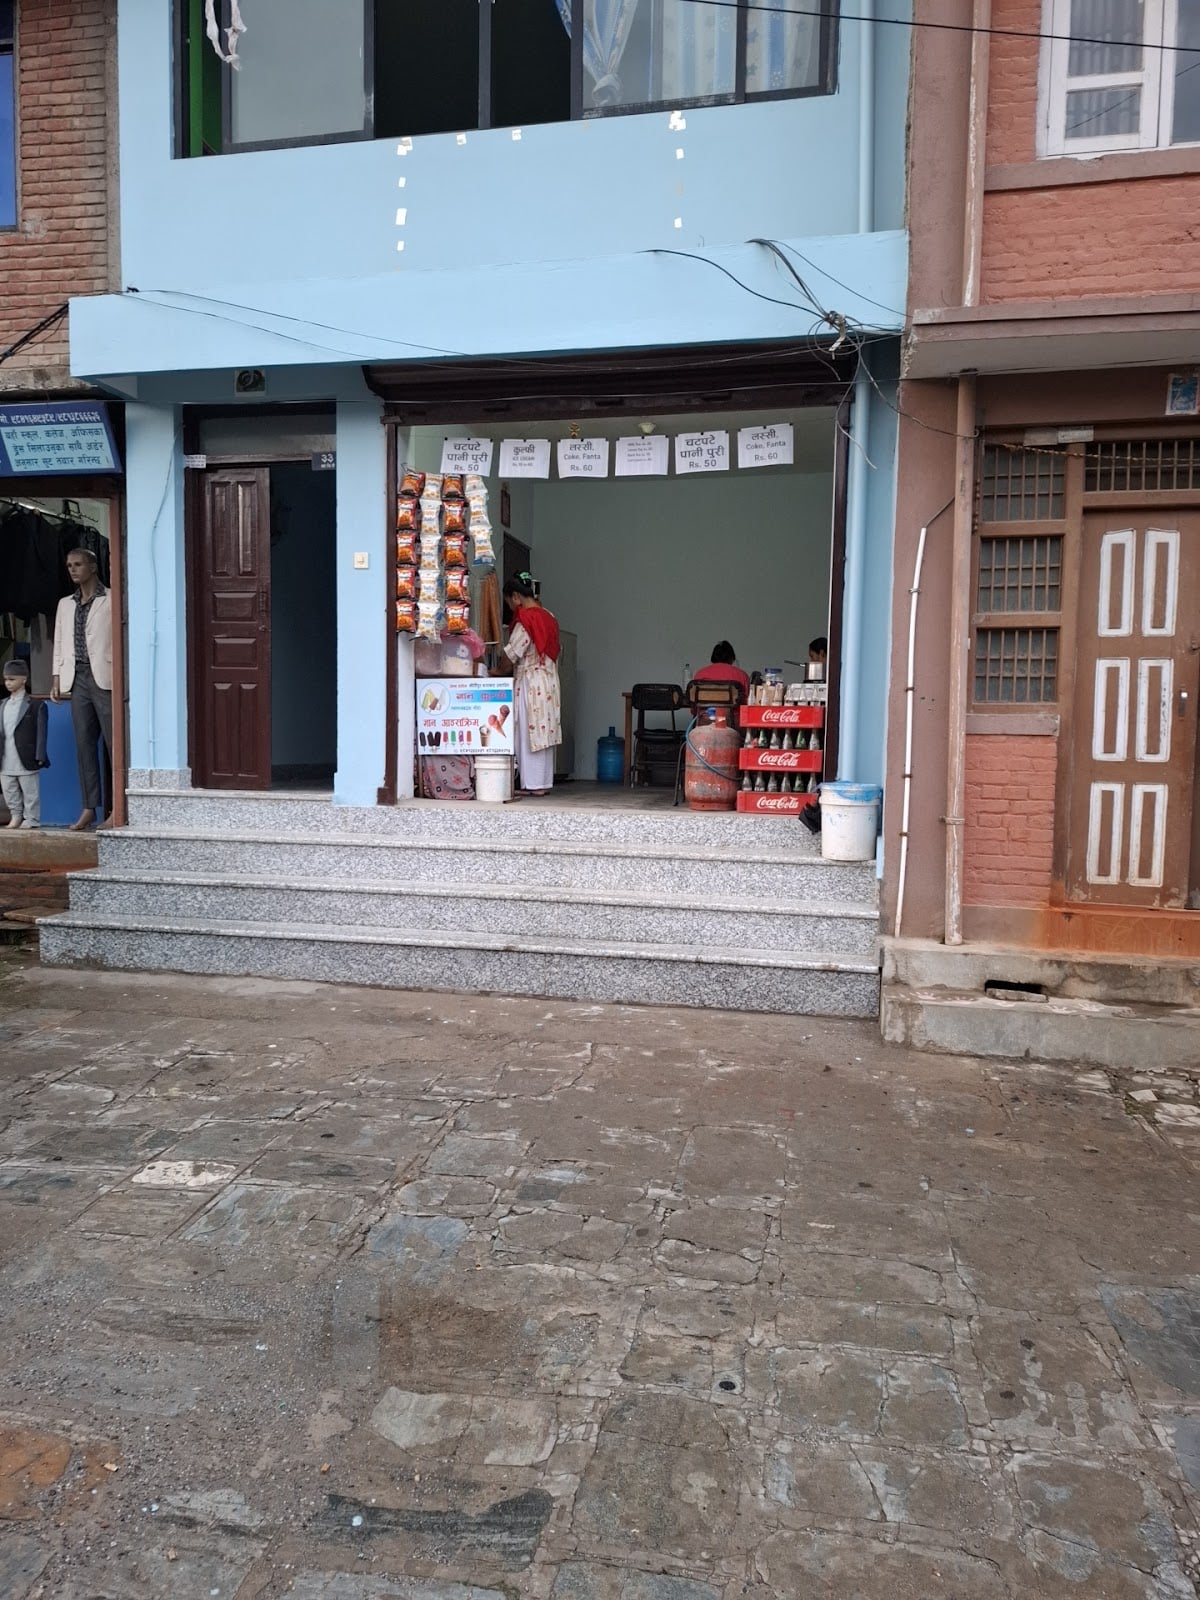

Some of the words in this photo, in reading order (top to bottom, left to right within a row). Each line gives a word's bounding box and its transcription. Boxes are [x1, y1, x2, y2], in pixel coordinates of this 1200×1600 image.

[685, 434, 715, 446] चटपटे
[766, 440, 786, 448] Fanta
[454, 441, 481, 451] चटपटे
[680, 446, 703, 458] पानी
[707, 445, 725, 458] पुरी
[447, 452, 469, 461] पानी
[472, 452, 488, 463] पुरी
[768, 452, 778, 460] 60
[704, 459, 717, 467] 50
[761, 709, 802, 723] Coca-Cola
[758, 751, 801, 767] Coca-Cola
[756, 796, 799, 809] Coca-Cola
